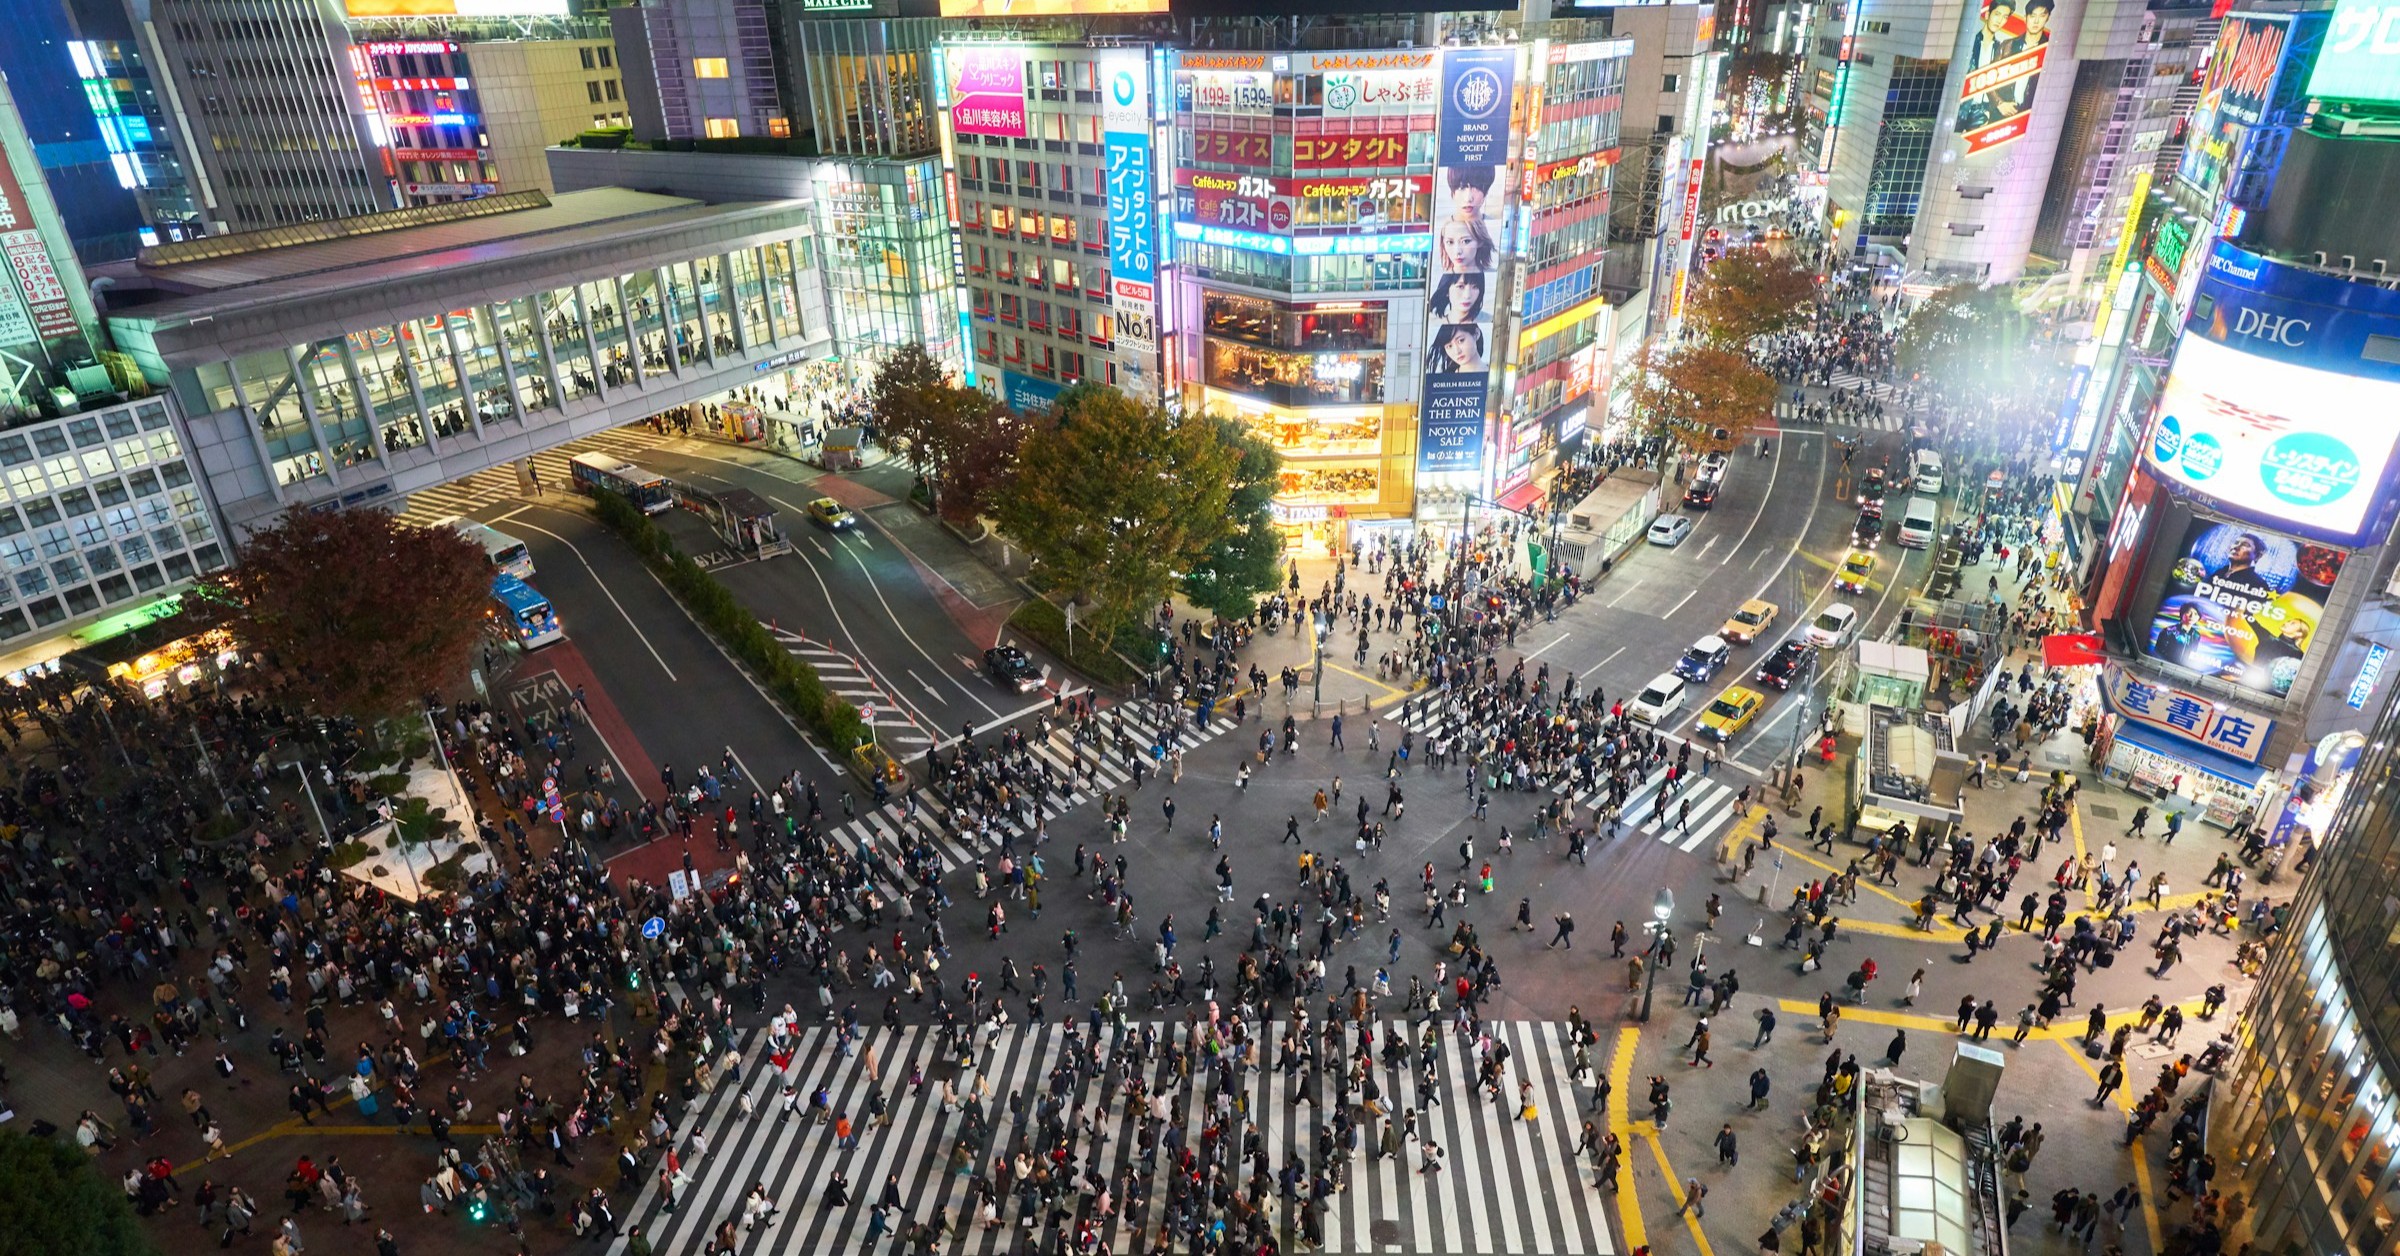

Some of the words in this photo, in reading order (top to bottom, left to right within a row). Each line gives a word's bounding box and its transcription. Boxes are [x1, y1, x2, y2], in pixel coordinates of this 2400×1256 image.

[405, 43, 445, 53] JOYSOUND
[1181, 55, 1265, 69] しゃぶしゃぶバイキング
[1312, 54, 1434, 69] しゃぶしゃぶバイキング
[980, 71, 1015, 87] クリニック
[1177, 84, 1192, 98] 9F
[1363, 77, 1433, 103] しゃぶ葉
[962, 108, 1022, 128] 品川美容外科
[1109, 110, 1142, 126] eyecity
[1463, 123, 1489, 132] BRAND
[1196, 134, 1269, 159] プライス
[1295, 137, 1404, 161] コンタクト
[1238, 176, 1276, 199] ガスト
[1303, 184, 1366, 198] Caféレストラン
[1368, 178, 1420, 199] ガスト
[1110, 145, 1131, 268] アイシティ
[1131, 147, 1148, 271] コンタクトの
[1179, 197, 1195, 212] 7F
[1199, 198, 1218, 212] Café
[1220, 199, 1264, 227] ガスト
[1273, 213, 1289, 221] ガスト
[2209, 253, 2223, 270] DHC
[2222, 259, 2259, 281] Channel
[1120, 283, 1150, 299] 当ビル5階
[1116, 310, 1154, 342] No.1
[2234, 306, 2311, 347] DHC
[1116, 336, 1154, 352] コンタクトショップ
[1428, 410, 1452, 420] THE
[1428, 427, 1458, 437] NOW
[1459, 426, 1477, 436] ON
[1440, 437, 1464, 446] SALE
[2198, 494, 2219, 509] DHC
[2212, 575, 2268, 598] teamLab
[2194, 582, 2286, 621] Planets
[2217, 606, 2256, 623] TOKYO
[2206, 618, 2253, 641] TOYOSU
[2207, 739, 2226, 750] BOOKS
